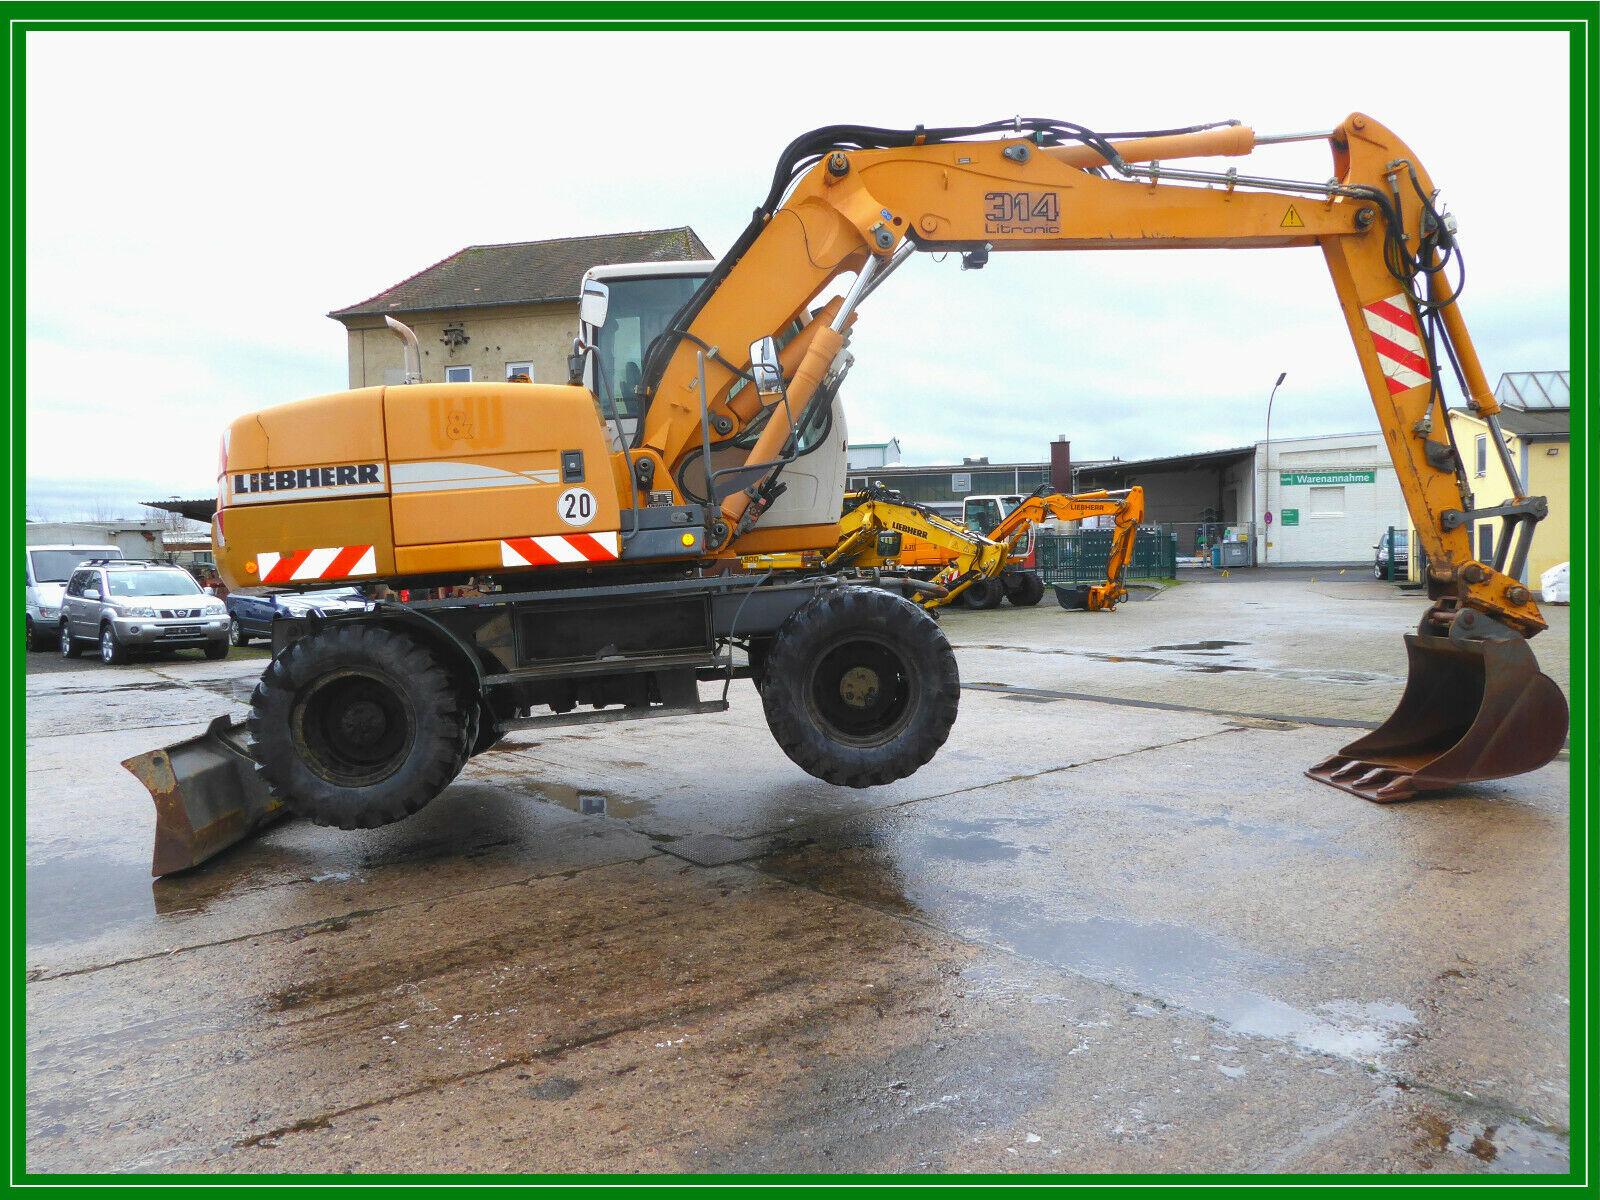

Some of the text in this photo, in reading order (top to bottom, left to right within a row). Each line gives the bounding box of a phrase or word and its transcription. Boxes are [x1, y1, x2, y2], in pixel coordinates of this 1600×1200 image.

[984, 193, 1059, 221] 314
[984, 224, 1060, 234] Litronic
[235, 464, 380, 494] LIEBHERR
[1296, 473, 1370, 484] Warenannahme
[564, 493, 590, 518] 20
[1070, 503, 1104, 511] LIEBHERR
[892, 521, 928, 539] LIEBHERR
